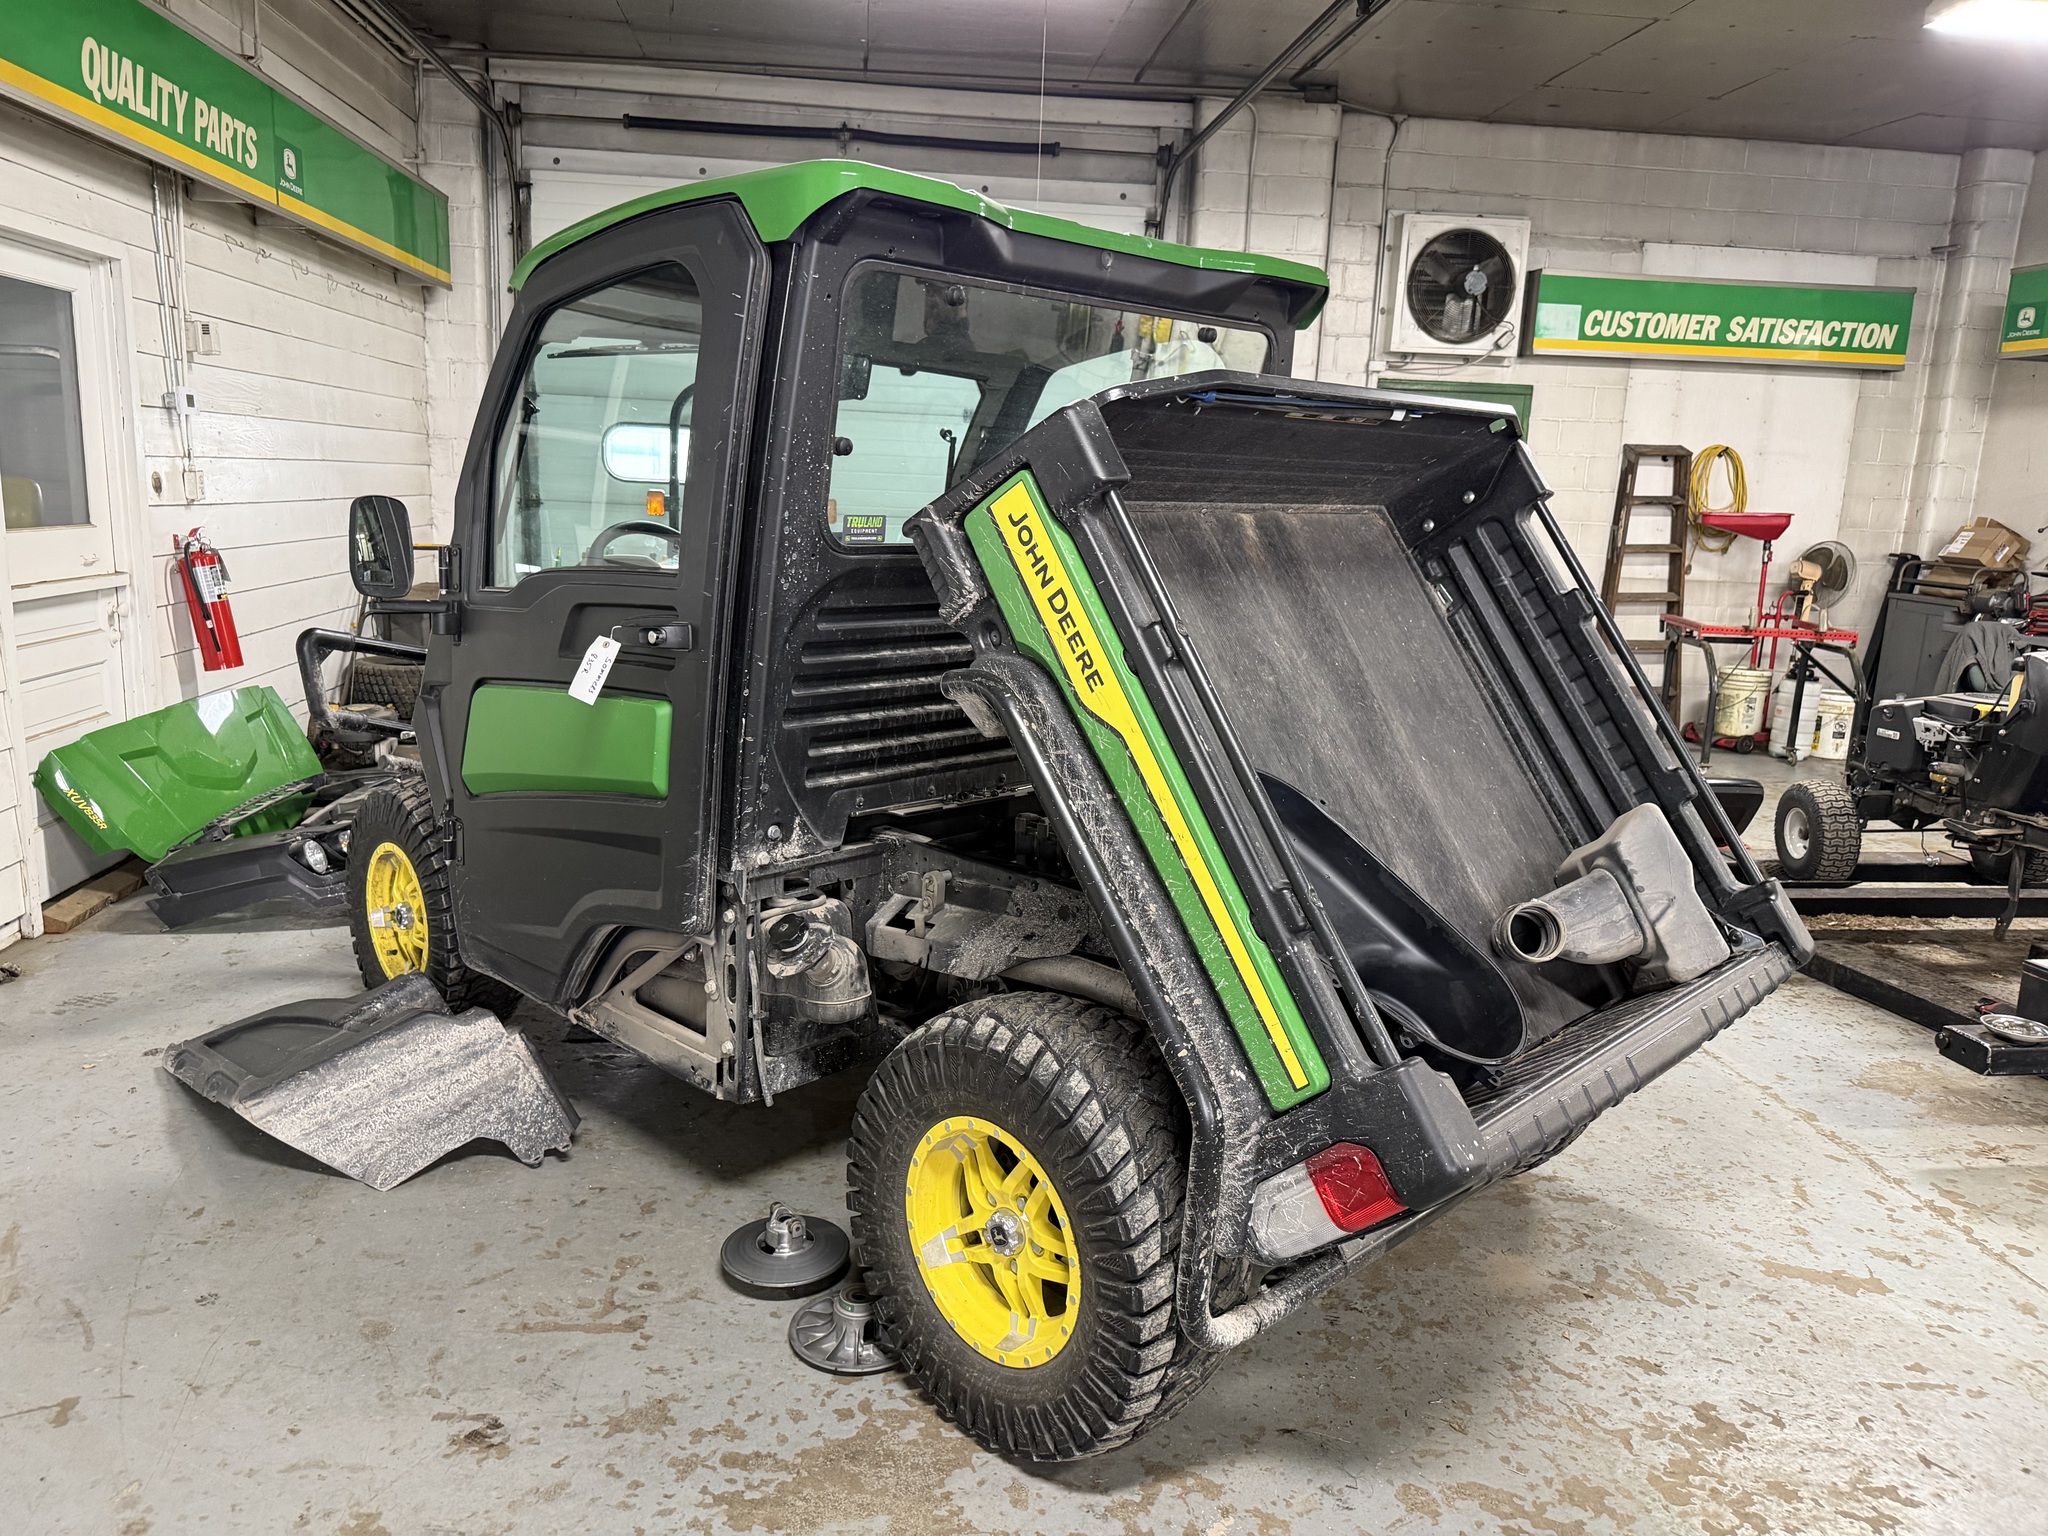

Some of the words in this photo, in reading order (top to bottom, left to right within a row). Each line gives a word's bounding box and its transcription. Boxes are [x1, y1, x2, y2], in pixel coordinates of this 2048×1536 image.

[81, 36, 189, 135] QUALITY
[194, 96, 258, 170] PARTS
[1583, 309, 1721, 342] CUSTOMER
[1725, 315, 1900, 350] SATISFACTION
[2006, 331, 2022, 339] JOHN
[2022, 328, 2041, 337] DEERE
[846, 516, 884, 528] TRULAND
[1008, 512, 1056, 590] JOHN
[1047, 587, 1105, 694] DEERE
[62, 788, 108, 830] XUV835R
